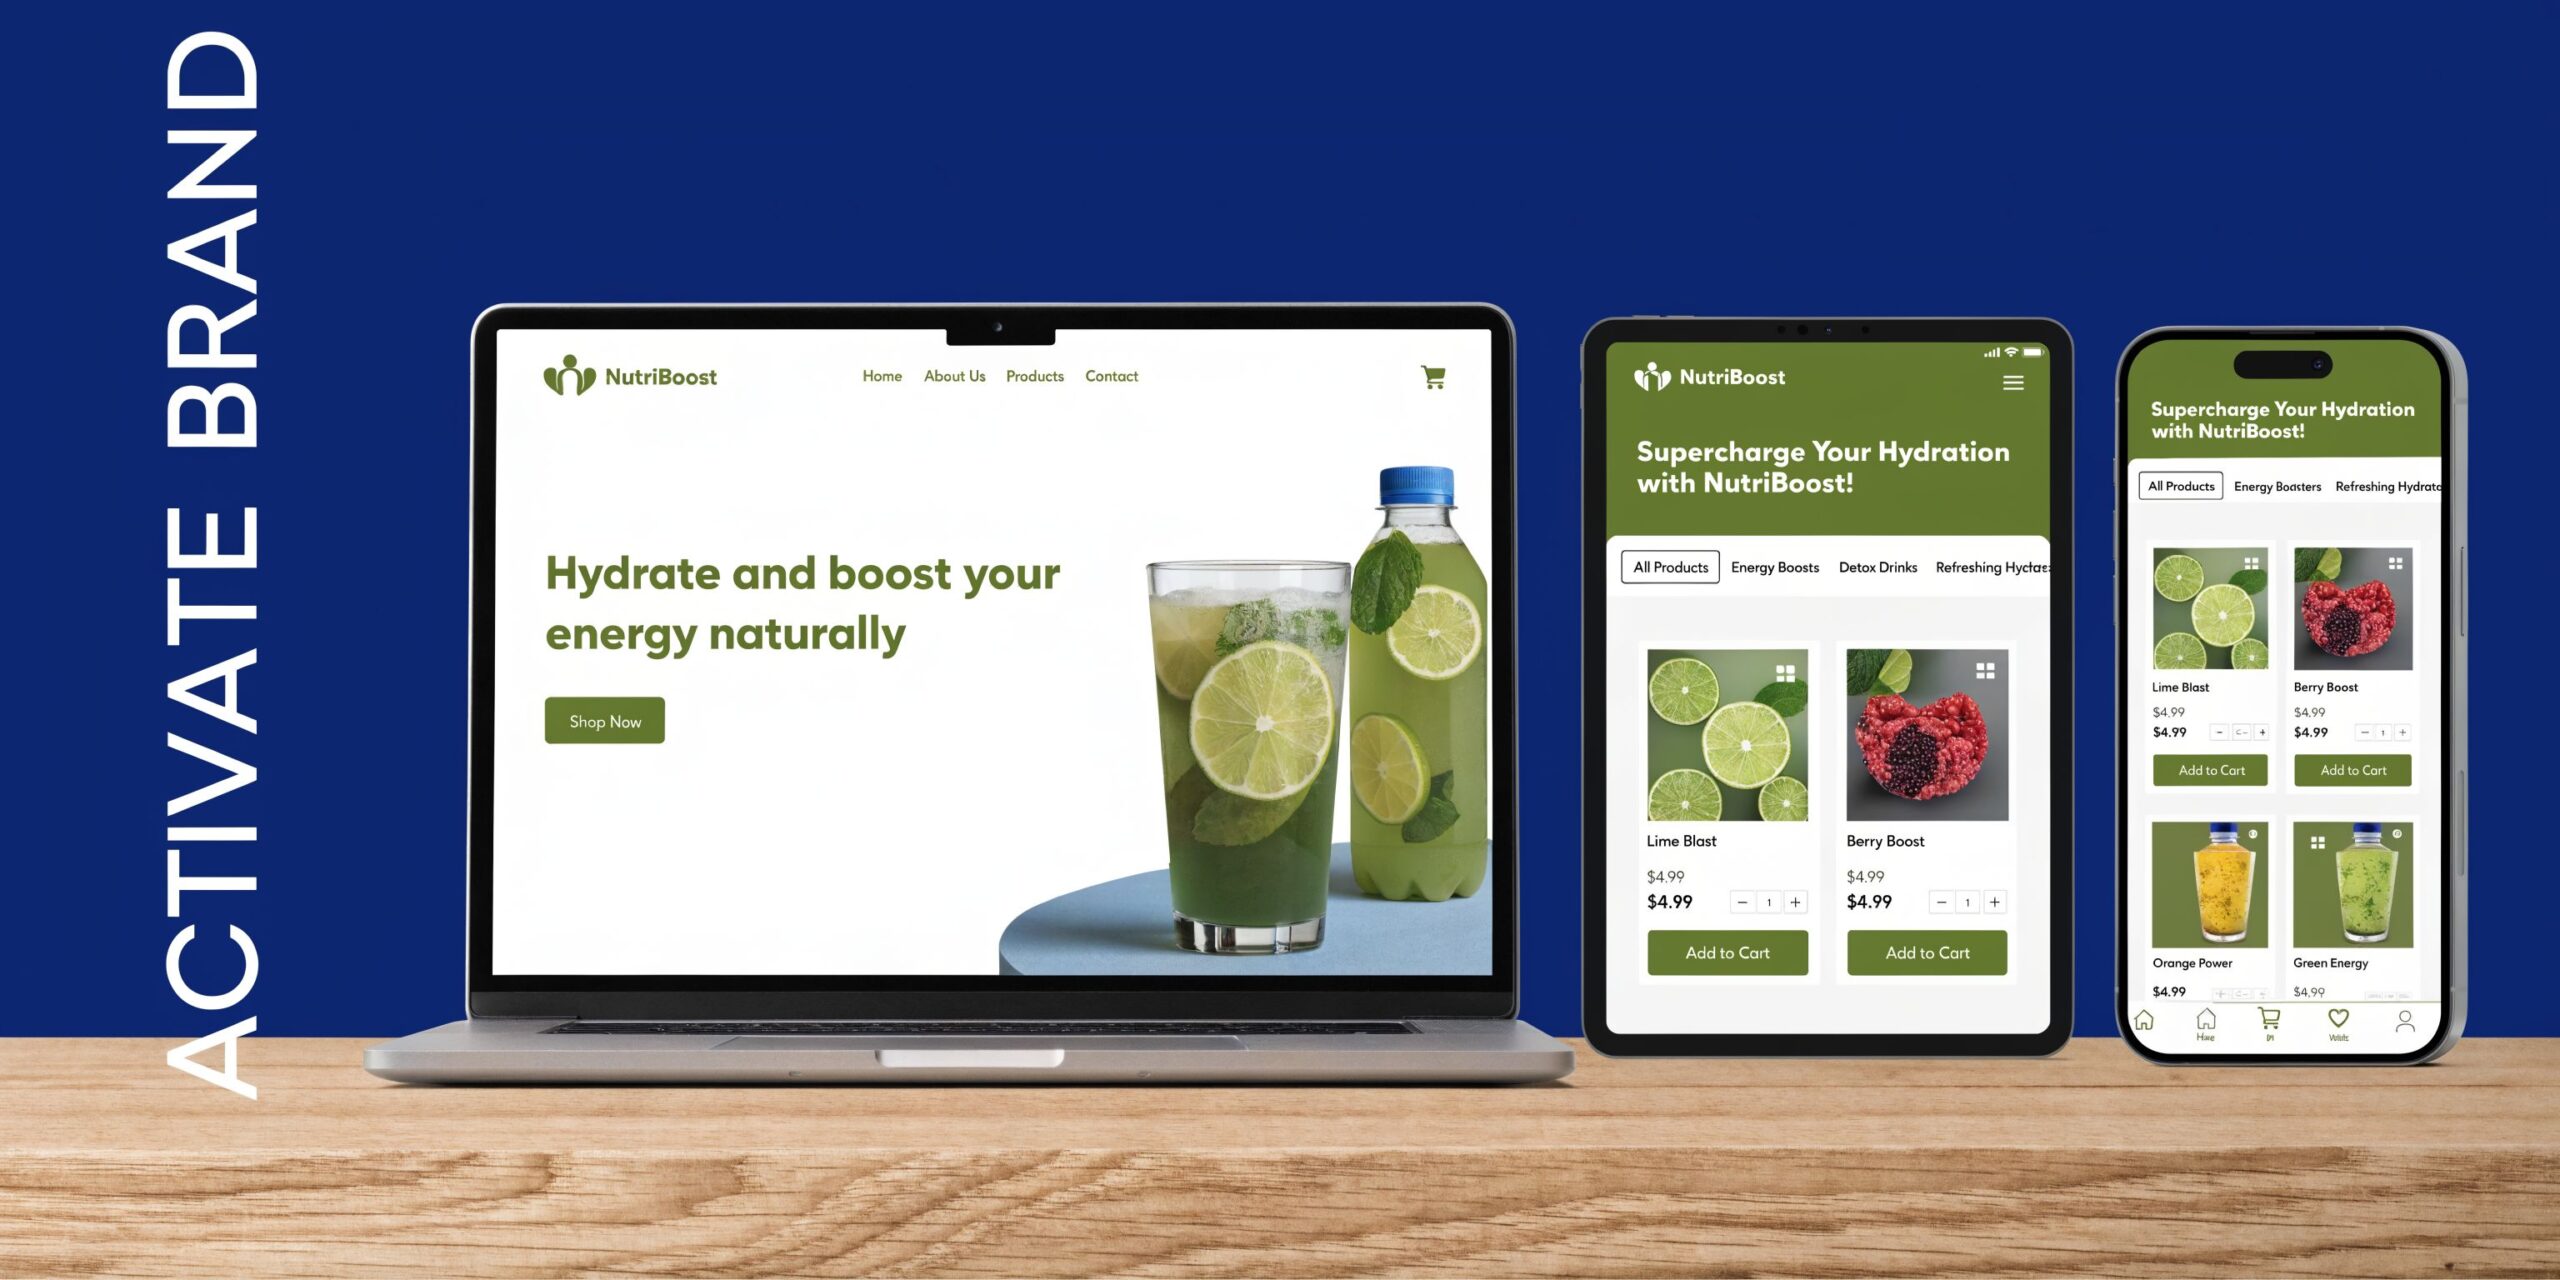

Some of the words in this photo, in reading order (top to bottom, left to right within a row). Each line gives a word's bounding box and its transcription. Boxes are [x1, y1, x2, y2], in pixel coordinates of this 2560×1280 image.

[606, 368, 717, 385] NutriBoost
[864, 370, 902, 382] Home
[924, 369, 965, 382] About
[970, 370, 986, 382] Us
[1007, 370, 1064, 382] Products
[1086, 370, 1138, 382] Contact
[1681, 368, 1785, 385] NutriBoost
[2152, 401, 2270, 420] Supercharge
[2274, 401, 2317, 416] Your
[2322, 401, 2415, 420] Hydration
[2152, 423, 2193, 438] with
[2199, 422, 2304, 438] NutriBoost!
[1638, 441, 1805, 468] Supercharge
[1812, 440, 1871, 462] Your
[1879, 441, 2009, 468] Hydration
[1637, 472, 1695, 493] with
[1705, 471, 1853, 493] NutriBoost!
[2148, 480, 2163, 491] All
[2167, 481, 2215, 491] Products
[2235, 481, 2273, 494] Energy
[2336, 481, 2394, 494] Refreshing
[1634, 561, 1650, 573] All
[1655, 561, 1708, 573] Products
[1732, 561, 1775, 576] Energy
[1779, 562, 1819, 573] Boosts
[1840, 562, 1876, 573] Detox
[1880, 561, 1917, 573] Drinks
[1937, 561, 2001, 576] Refreshing
[548, 555, 720, 599] Hydrate
[733, 555, 815, 590] and
[830, 555, 951, 590] boost
[963, 565, 1060, 599] your
[546, 625, 698, 660] energy
[711, 614, 906, 659] naturally
[2153, 682, 2179, 692] Lime
[2182, 682, 2209, 692] Blast
[2295, 682, 2324, 694] Berry
[2327, 682, 2358, 692] Boost
[2153, 707, 2185, 718] $4.99
[2295, 707, 2325, 717] $4.99
[571, 715, 605, 731] Shop
[611, 715, 641, 728] Now
[2154, 727, 2186, 738] $4.99
[2295, 726, 2328, 738] $4.99
[2179, 765, 2202, 775] Add
[2206, 767, 2217, 775] to
[2221, 765, 2245, 775] Cart
[2321, 764, 2344, 775] Add
[2348, 766, 2359, 775] to
[2363, 765, 2387, 775] Cart
[1648, 835, 1679, 847] Lime
[1684, 835, 1717, 847] Blast
[1848, 835, 1883, 850] Berry
[1887, 835, 1925, 847] Boost
[1648, 870, 1684, 884] $4.99
[1848, 870, 1884, 884] $4.99
[1648, 894, 1692, 910] $4.99
[1848, 893, 1892, 910] $4.99
[1686, 946, 1715, 959] Add
[1720, 948, 1734, 959] to
[1739, 946, 1770, 959] Cart
[1886, 946, 1915, 959] Add
[1920, 948, 1934, 959] to
[1939, 946, 1970, 959] Cart
[2153, 958, 2195, 970] Orange
[2199, 958, 2232, 968] Power
[2294, 958, 2327, 968] Green
[2331, 958, 2368, 970] Energy
[2153, 986, 2186, 998] $4.99
[2294, 986, 2325, 997] $4.99
